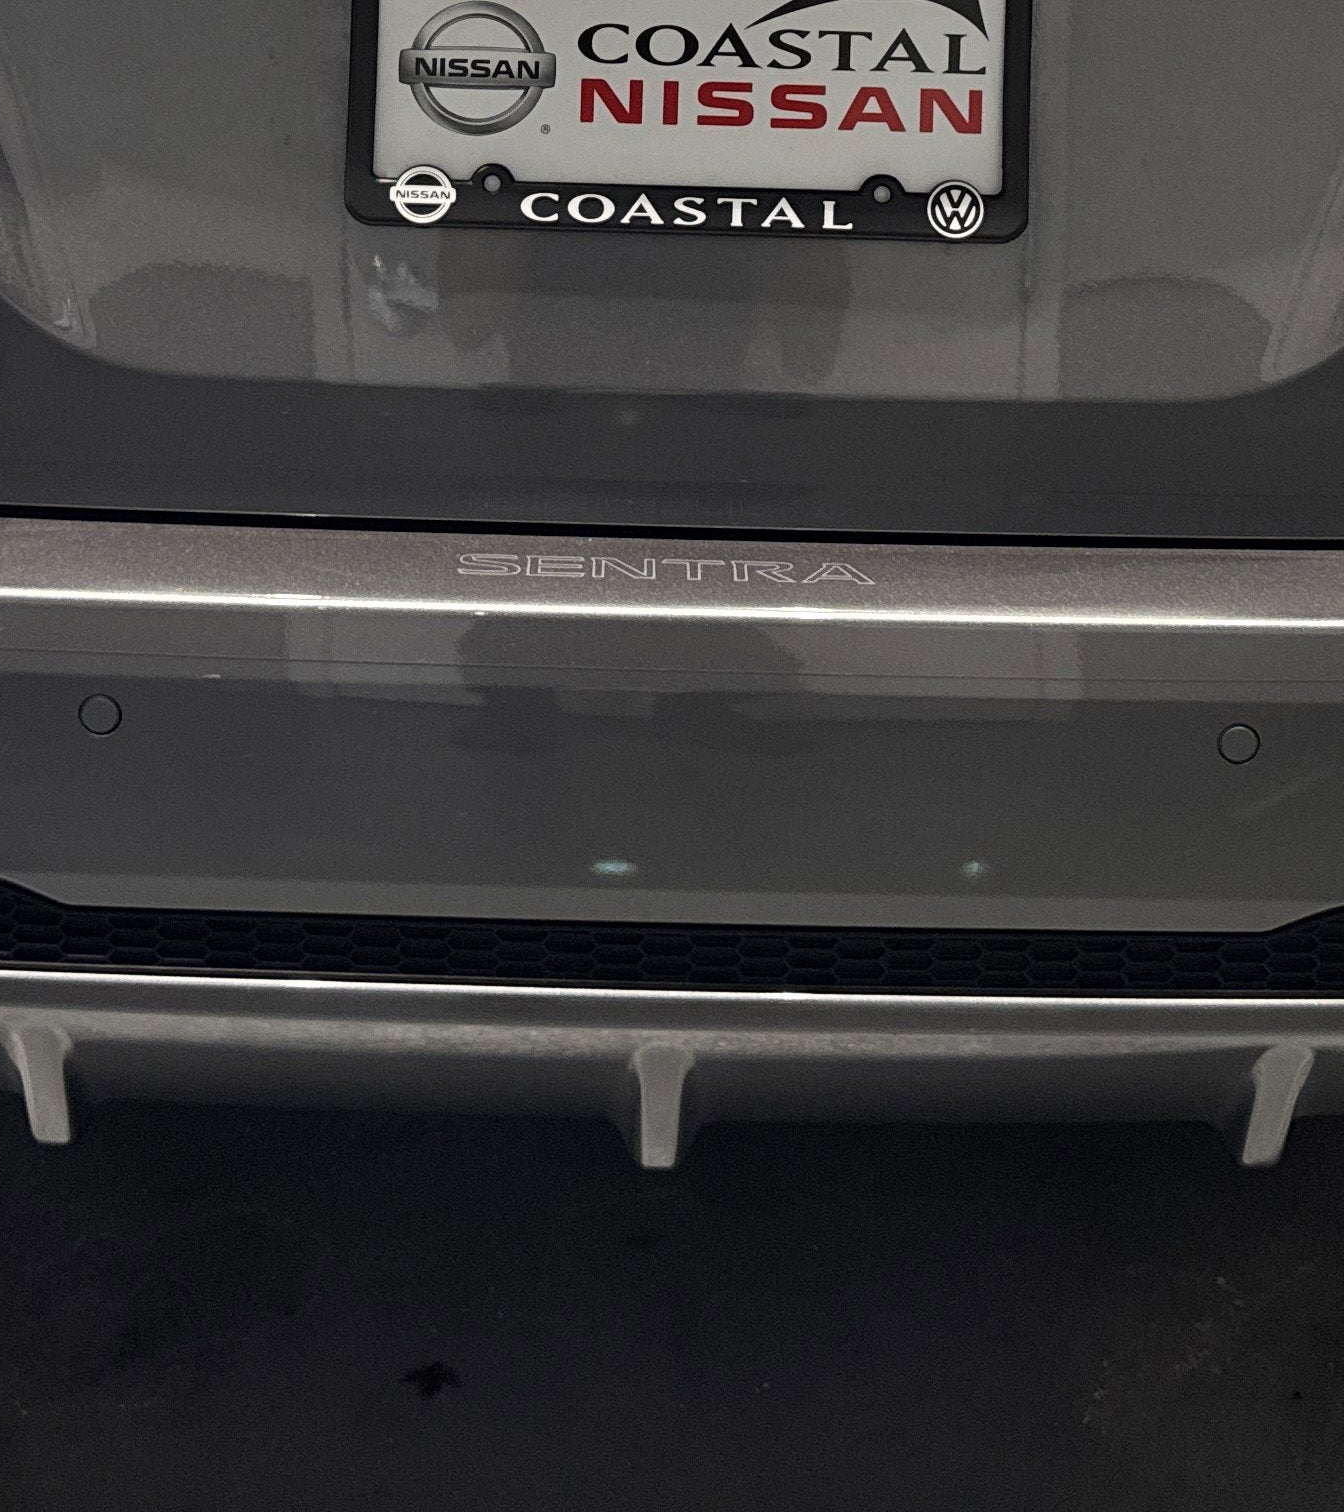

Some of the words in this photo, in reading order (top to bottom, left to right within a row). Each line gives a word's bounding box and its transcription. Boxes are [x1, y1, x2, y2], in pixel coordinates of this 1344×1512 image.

[577, 22, 987, 75] COASTAL
[414, 57, 541, 80] NISSAN
[579, 78, 984, 135] NISSAN
[394, 189, 452, 200] NISSAN
[520, 191, 854, 230] COASTAL
[457, 554, 876, 585] SENTRA
